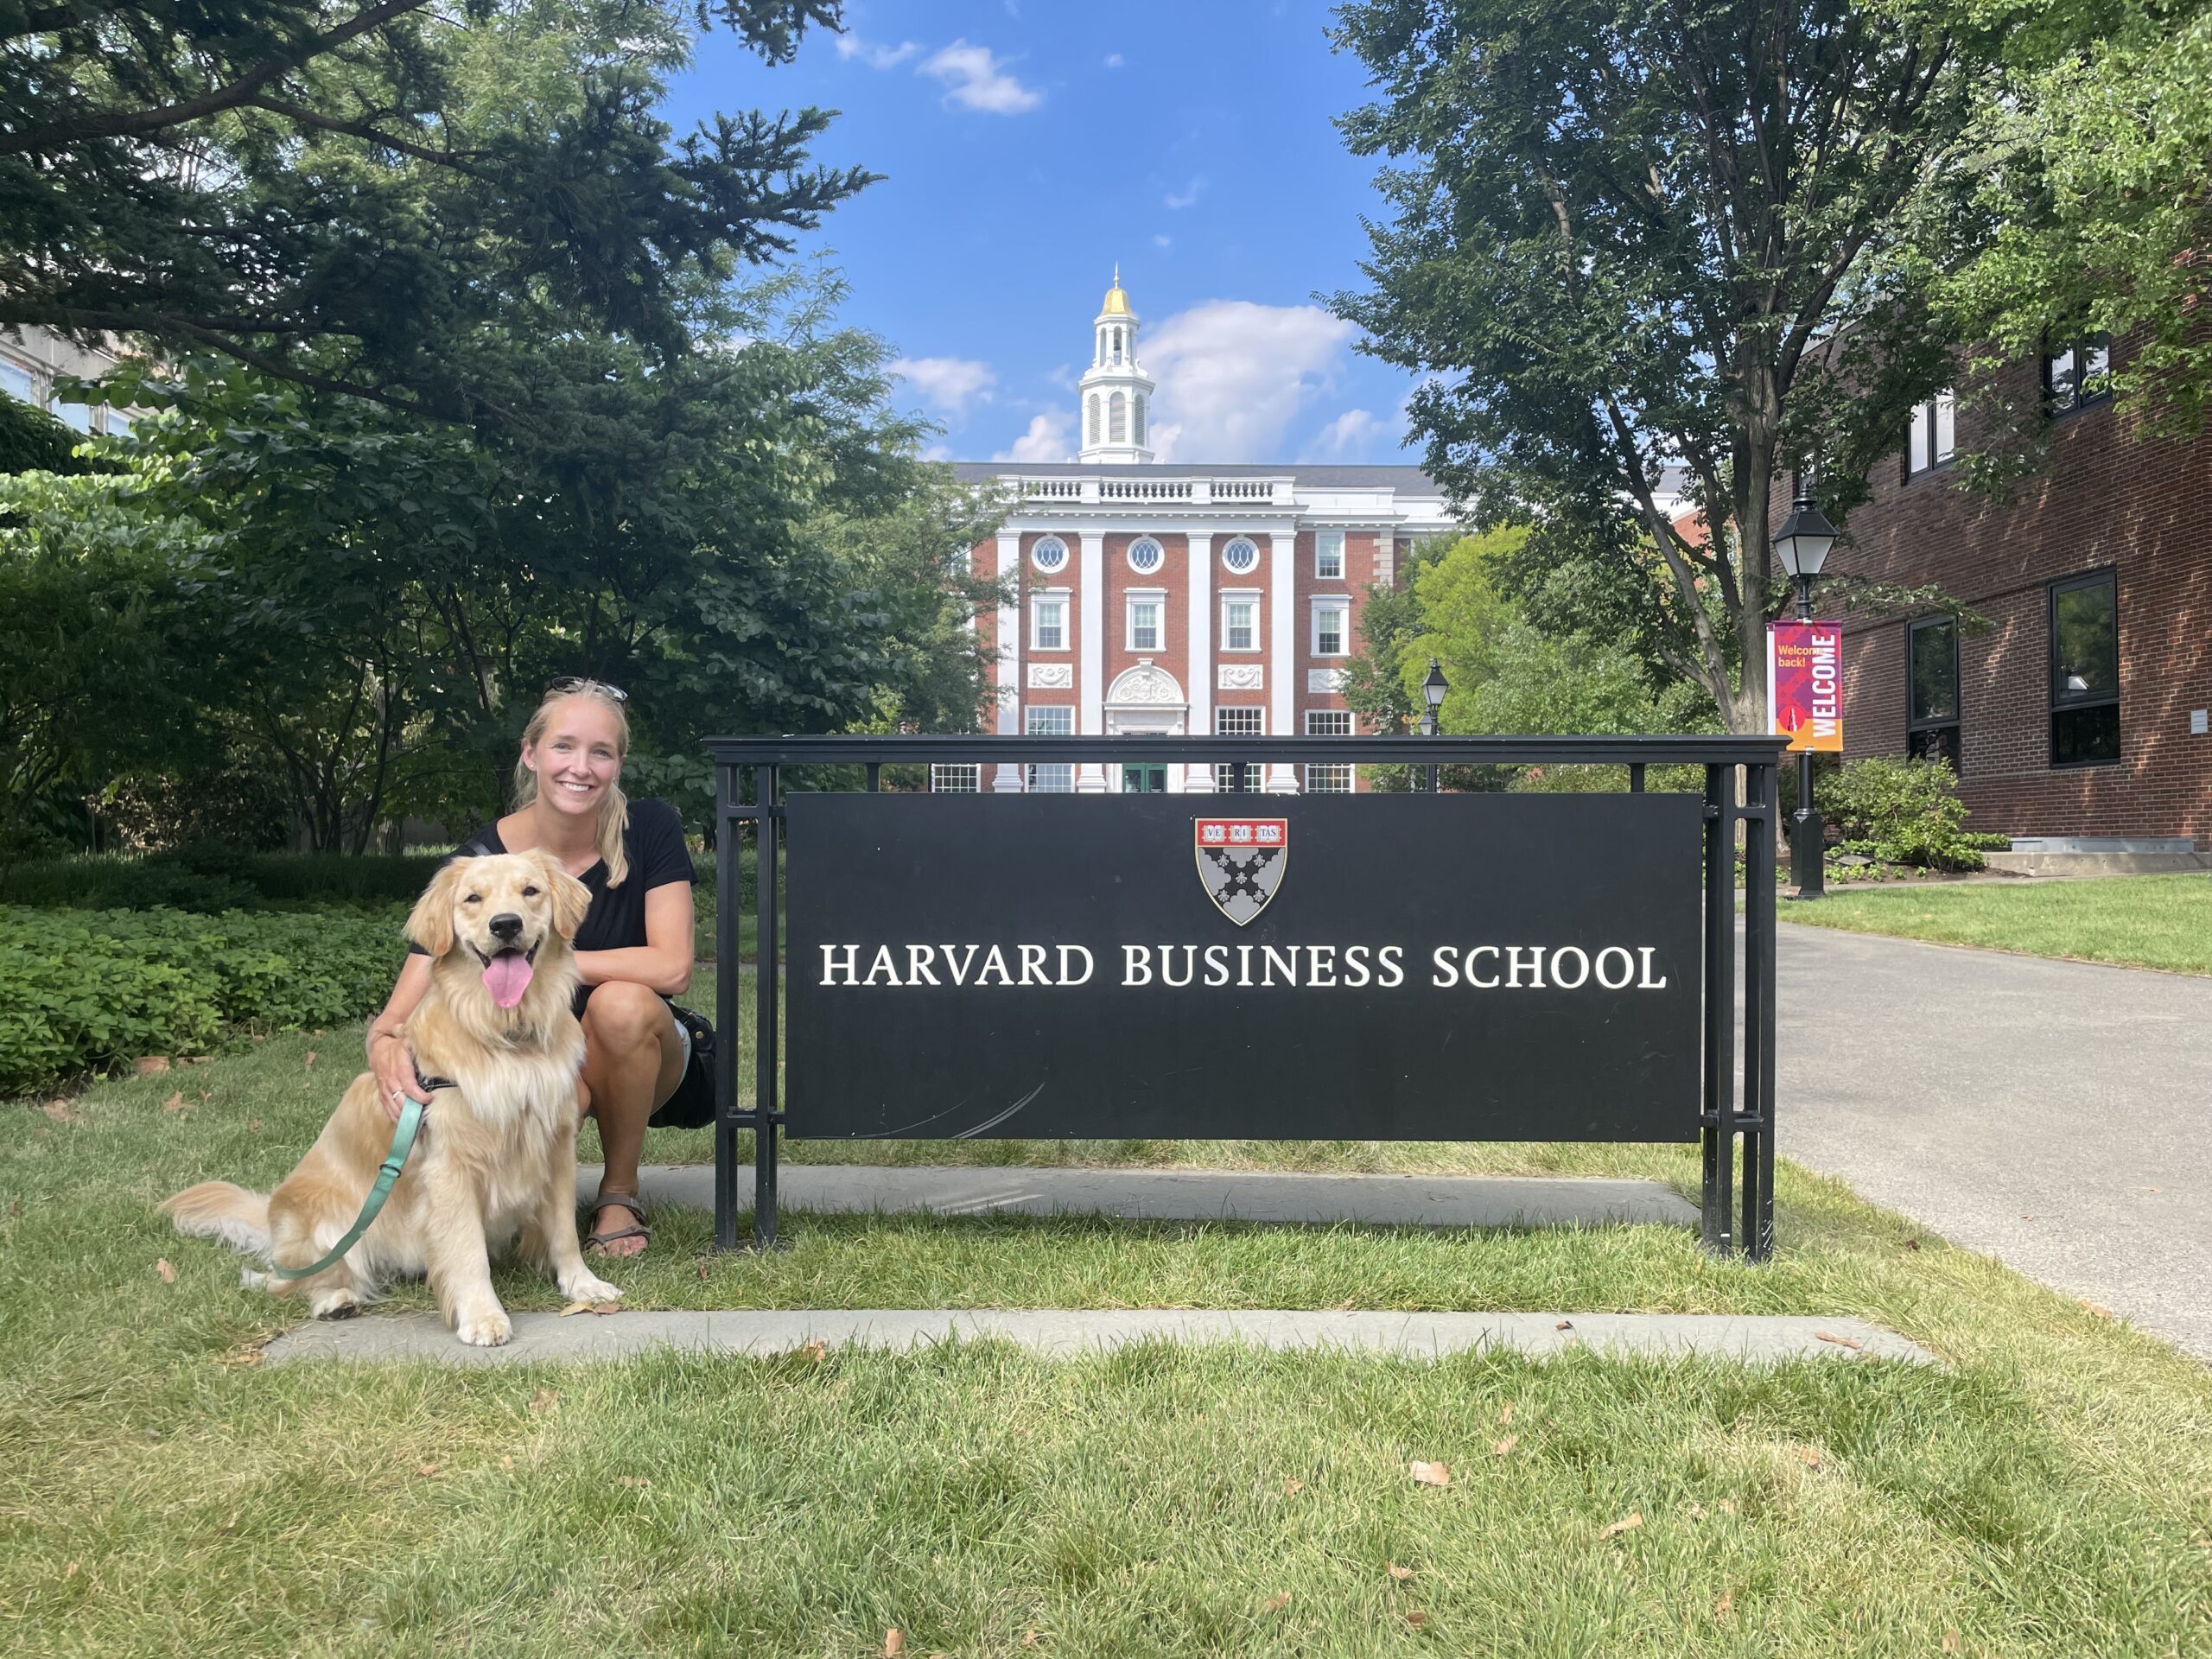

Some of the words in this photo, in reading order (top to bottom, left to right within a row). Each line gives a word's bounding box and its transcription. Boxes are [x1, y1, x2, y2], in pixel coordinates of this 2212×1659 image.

[1777, 657, 1806, 667] back!
[1811, 634, 1836, 737] WELCOME
[1207, 829, 1221, 837] VE
[1261, 829, 1277, 837] TAS
[818, 944, 1094, 986] HARVARD
[1121, 944, 1404, 988] BUSINESS
[1433, 945, 1669, 989] SCHOOL
